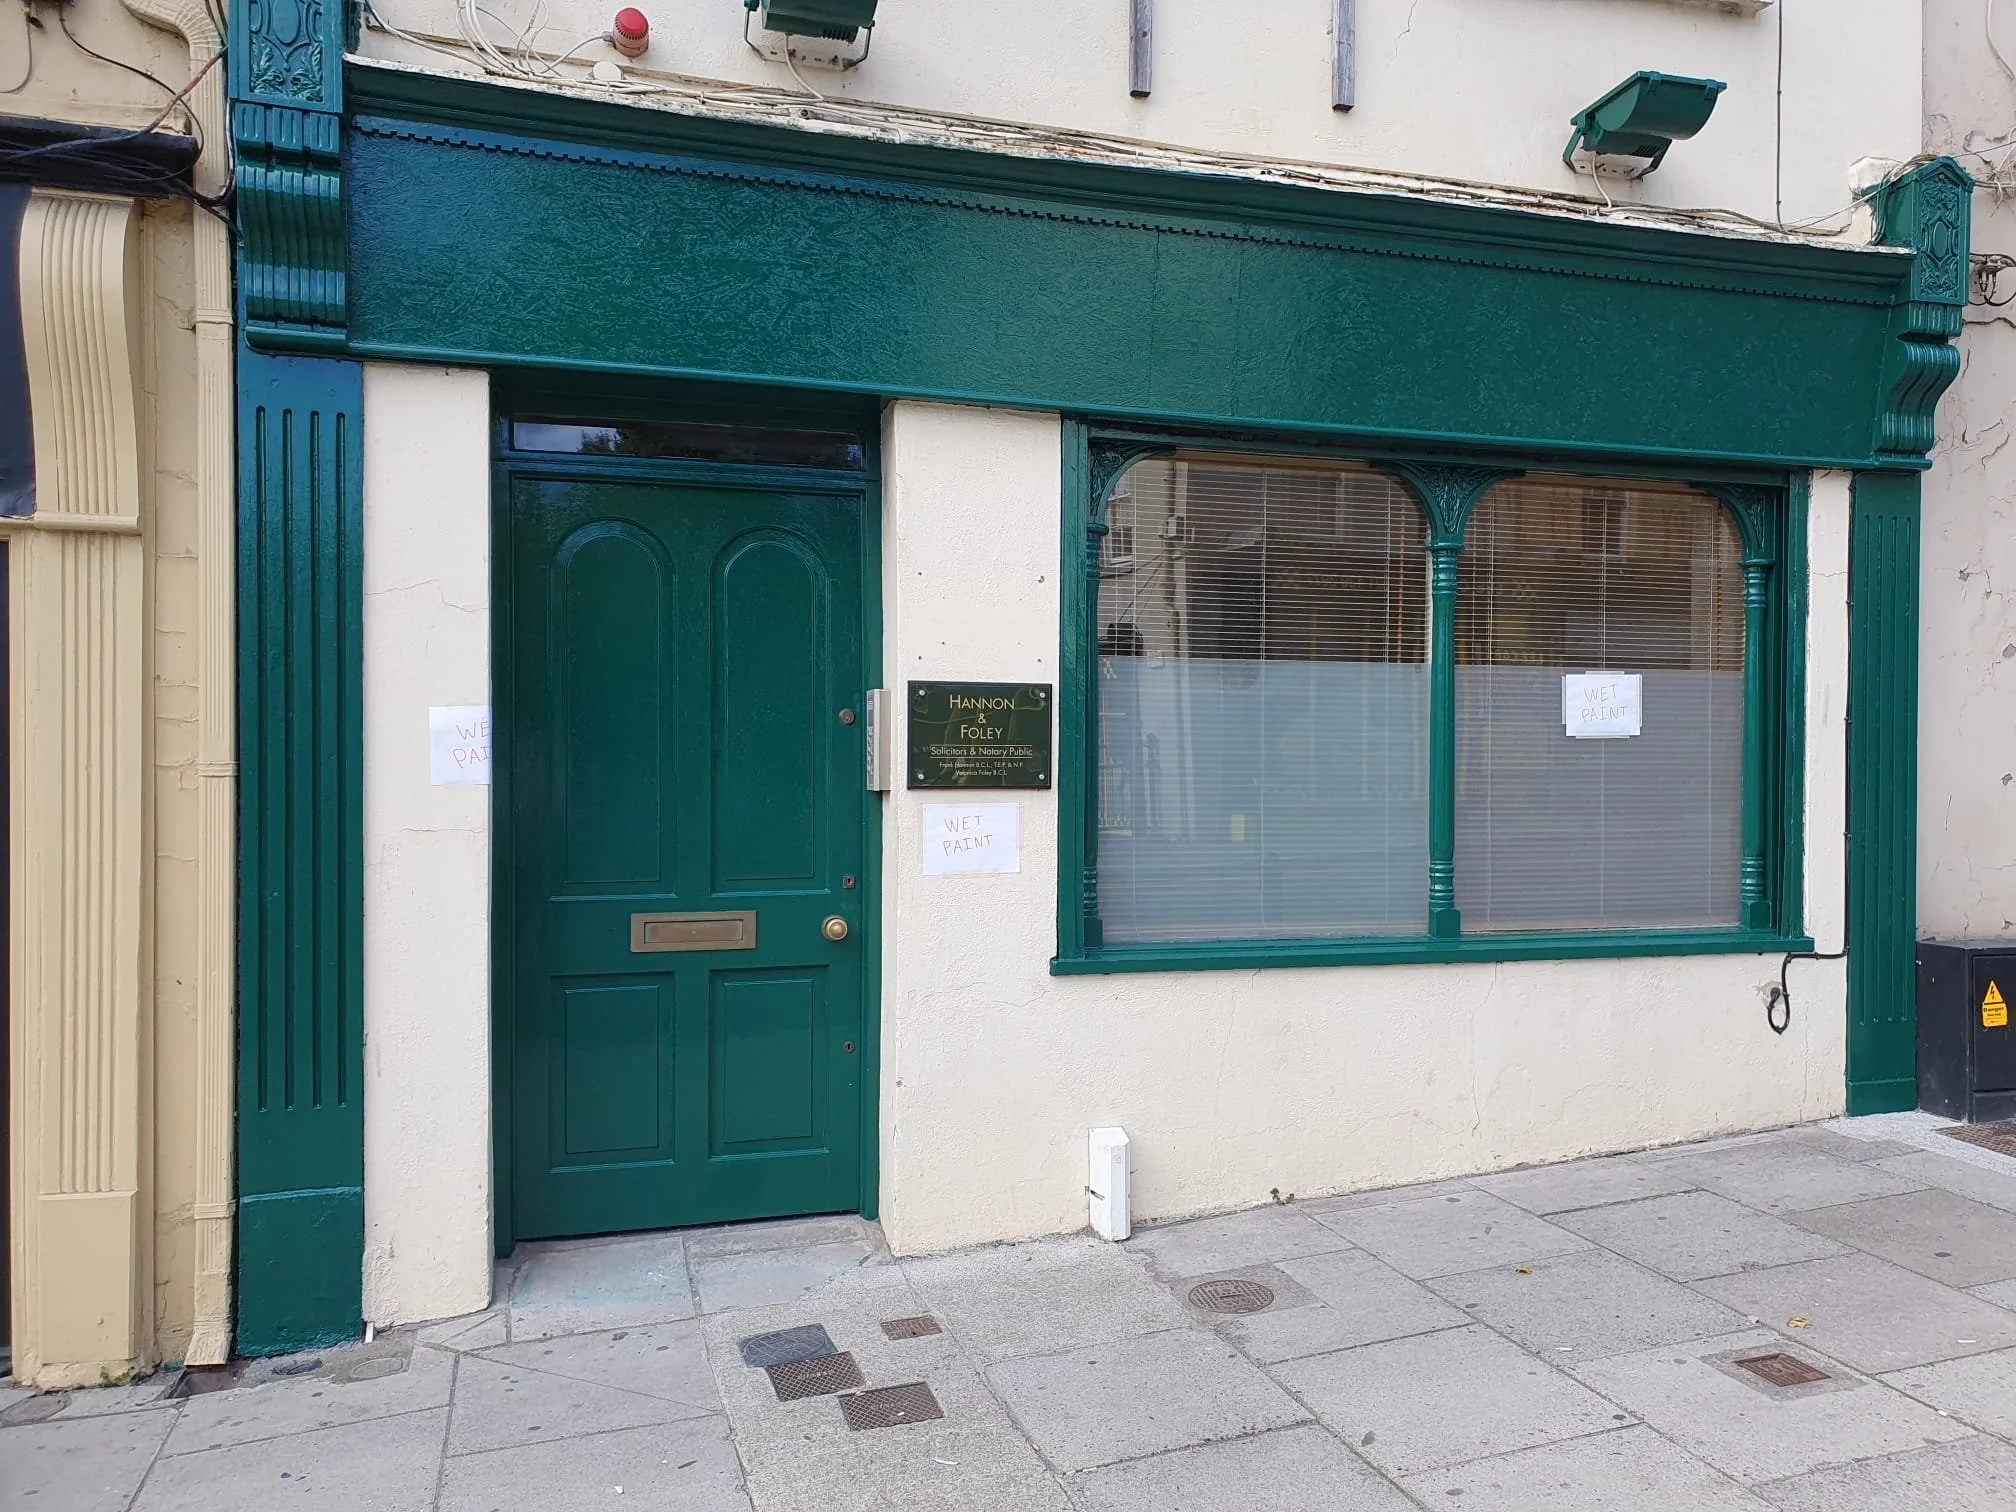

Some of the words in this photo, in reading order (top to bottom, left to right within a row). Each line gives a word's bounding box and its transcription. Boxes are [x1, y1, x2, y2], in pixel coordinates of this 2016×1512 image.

[949, 694, 1015, 710] HANNON
[1583, 684, 1620, 703] WET
[977, 712, 987, 724] &
[1581, 706, 1629, 724] PAINT
[456, 721, 490, 741] WE
[960, 724, 1003, 740] FOLEY
[452, 746, 490, 769] PAI
[931, 746, 968, 756] Solicitors
[969, 747, 976, 756] &
[979, 746, 1008, 758] Notary
[1009, 746, 1033, 756] Public
[944, 815, 984, 833] WET
[942, 834, 993, 857] PAINT
